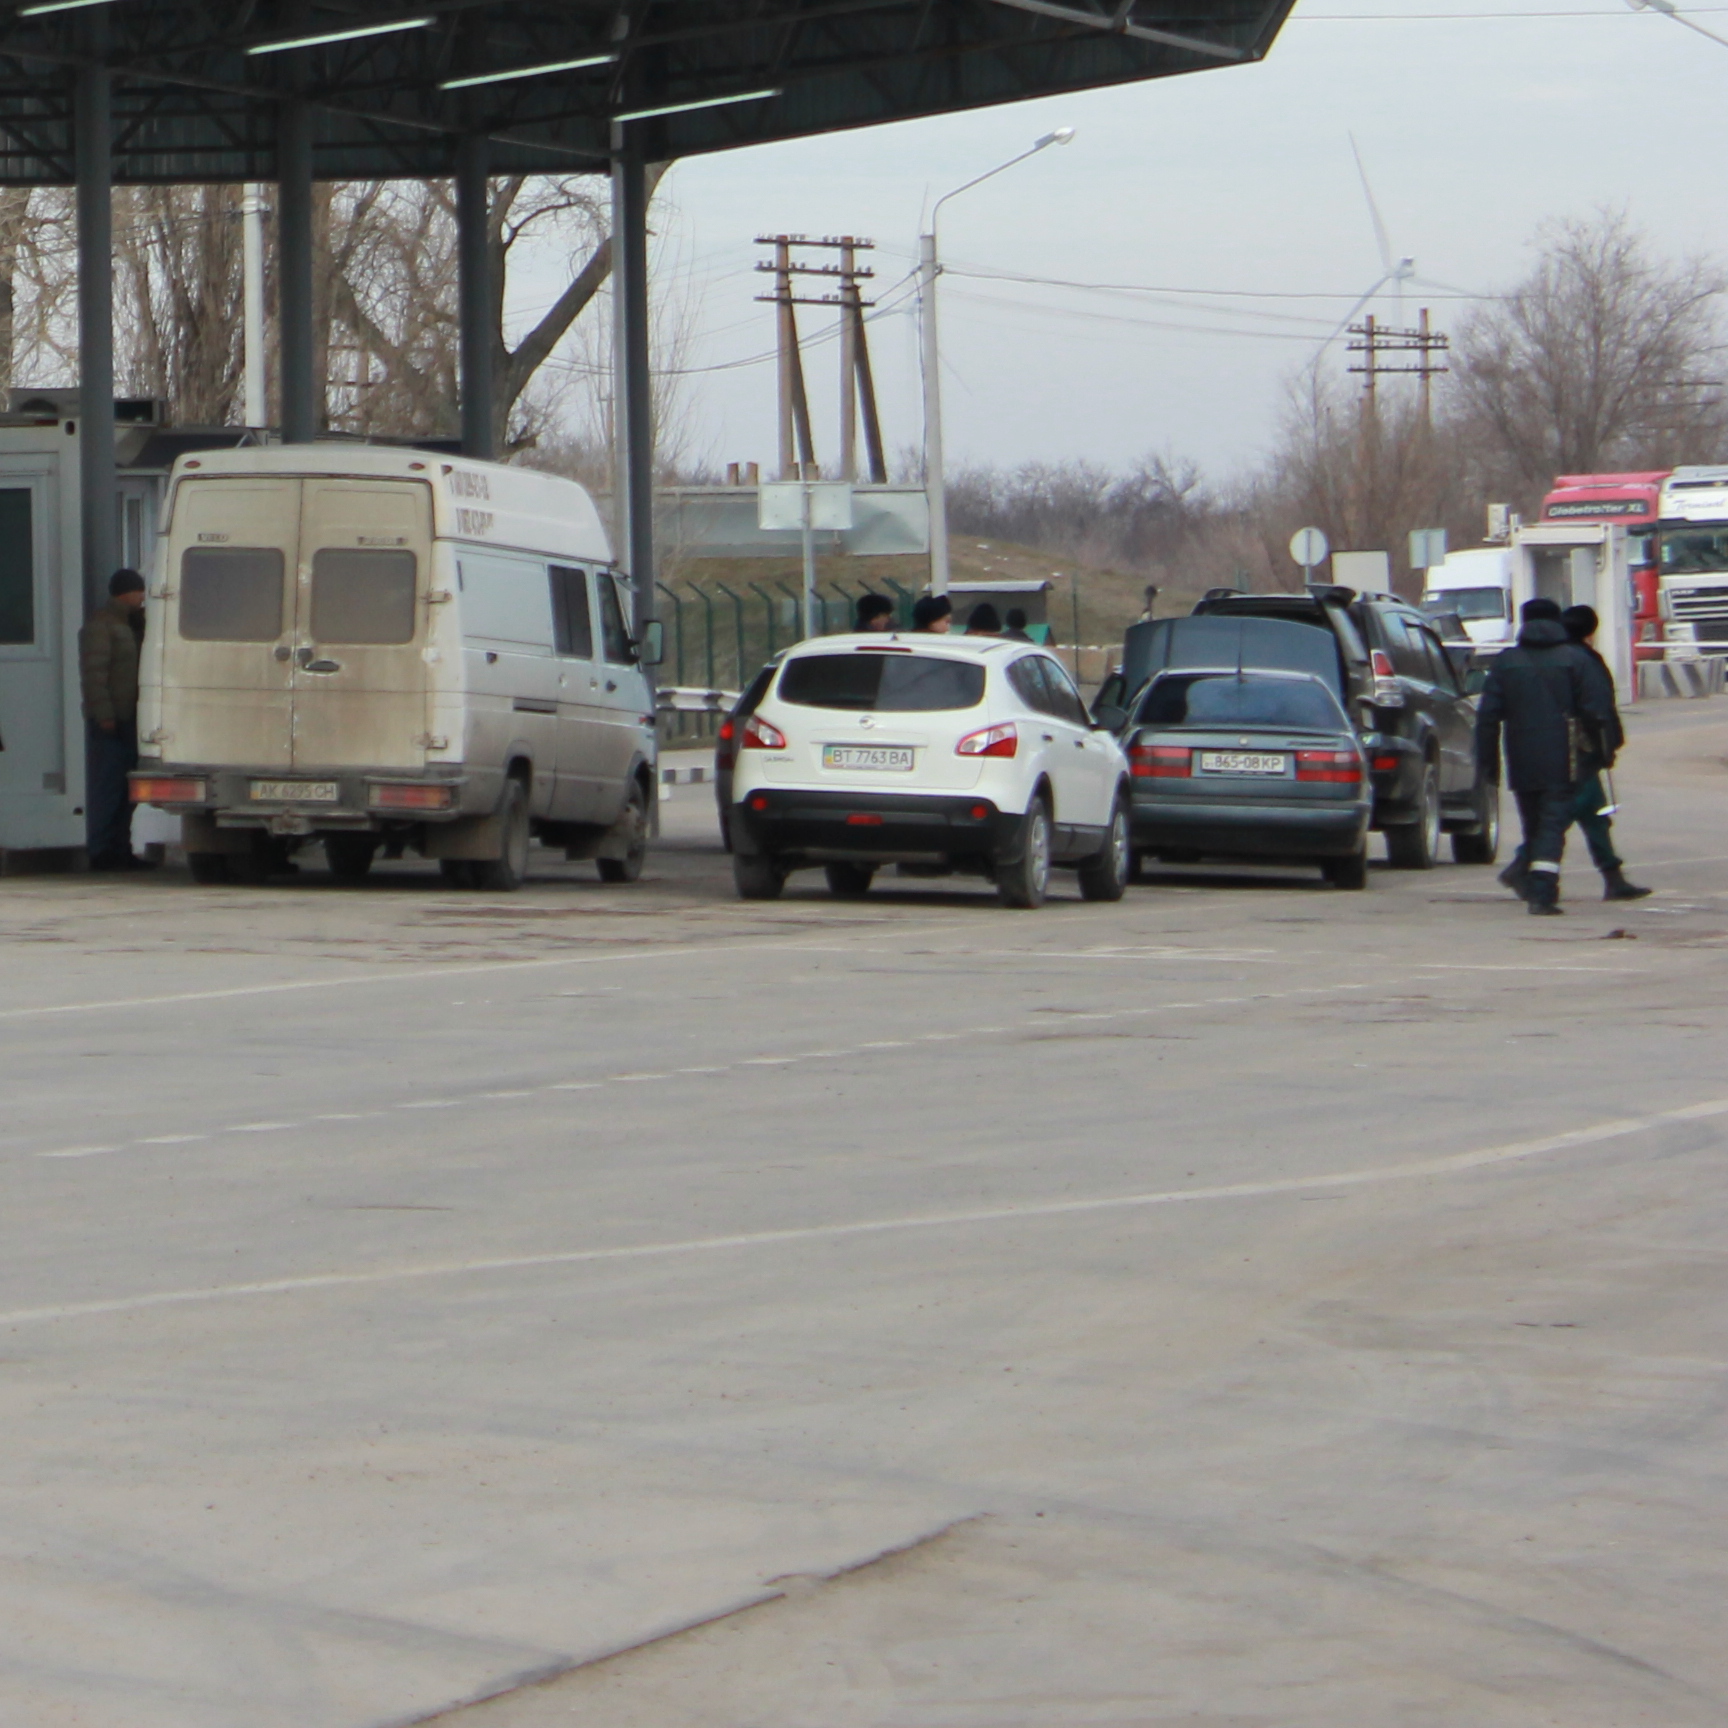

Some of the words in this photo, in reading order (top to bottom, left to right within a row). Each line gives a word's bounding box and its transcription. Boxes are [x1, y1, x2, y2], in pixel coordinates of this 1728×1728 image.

[1627, 503, 1645, 513] XL
[833, 749, 853, 763] BT
[856, 751, 886, 764] 7763
[889, 752, 909, 765] BA
[1215, 756, 1260, 769] 865-08
